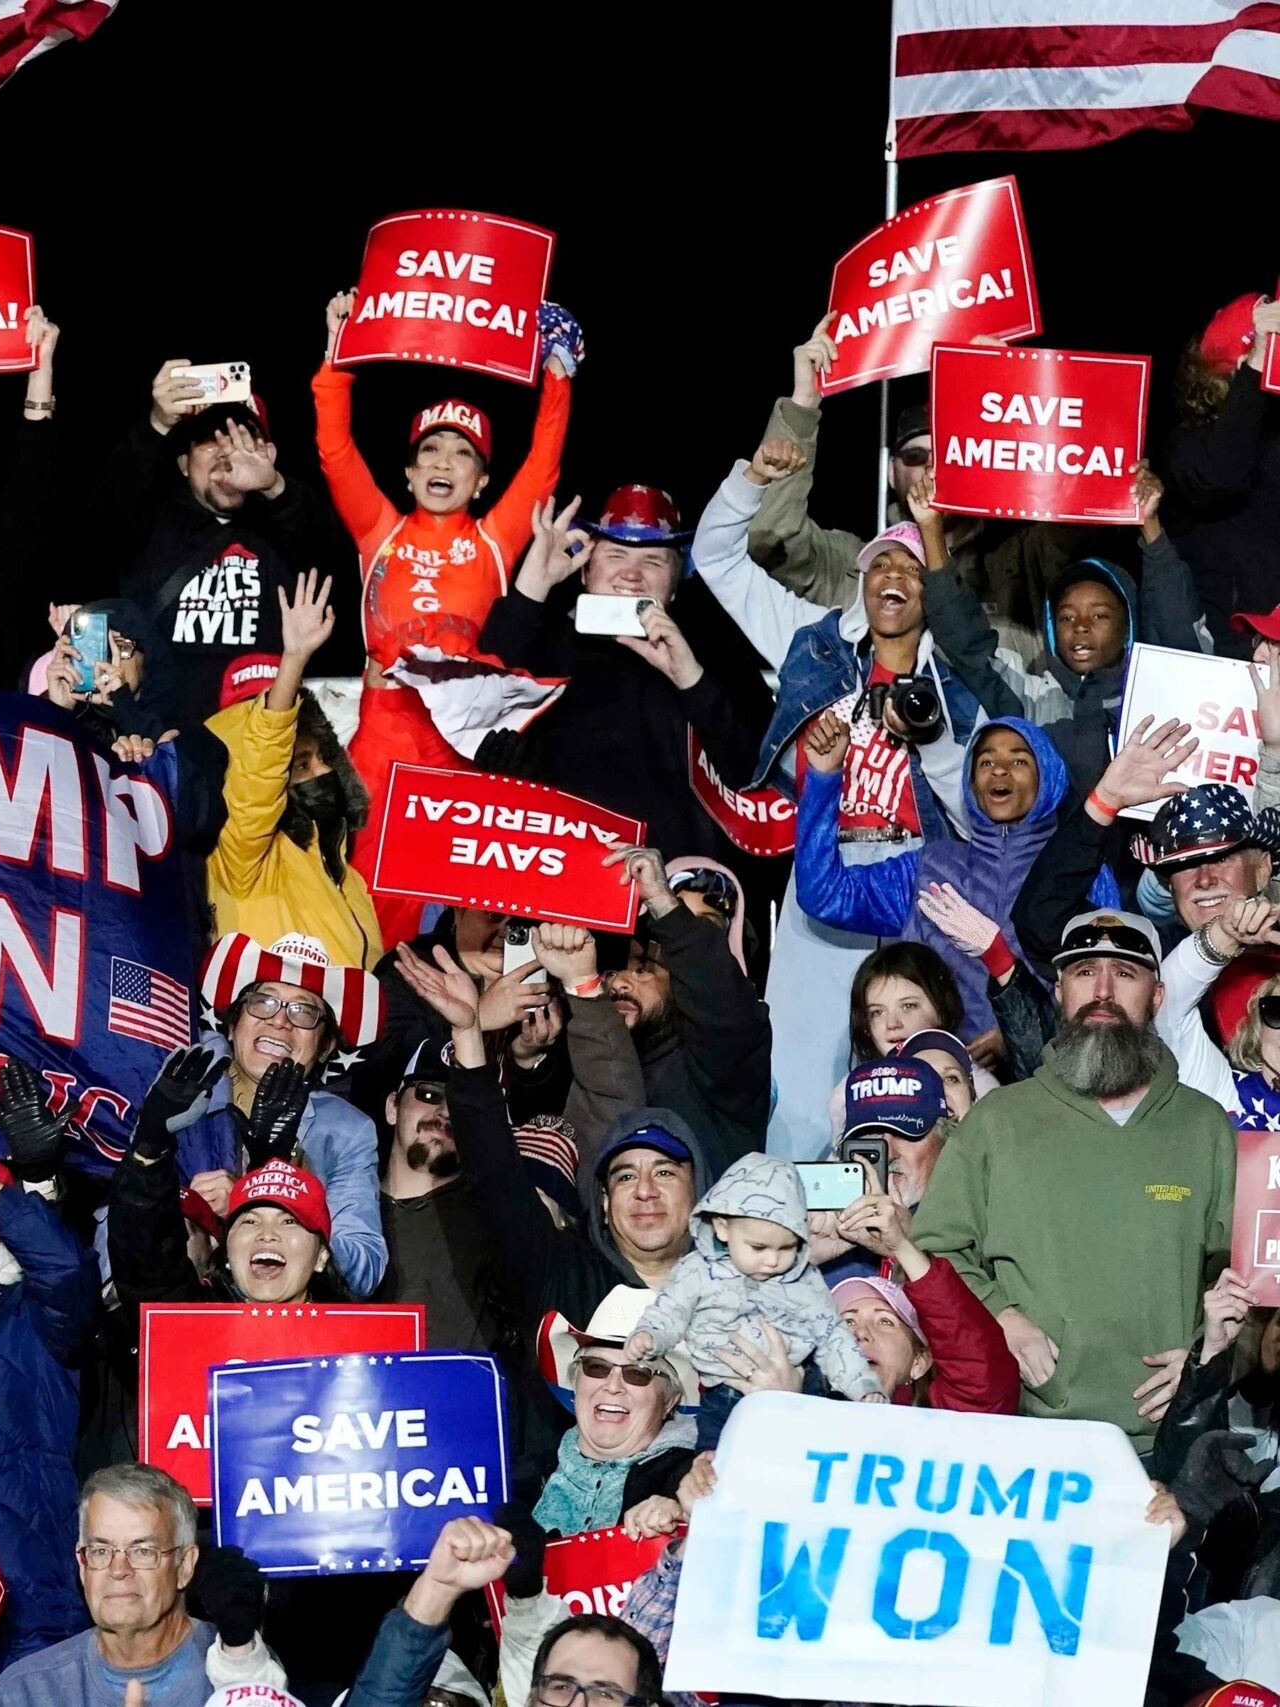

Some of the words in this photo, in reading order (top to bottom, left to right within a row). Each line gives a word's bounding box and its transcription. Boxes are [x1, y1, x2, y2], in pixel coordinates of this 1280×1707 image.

[396, 249, 495, 285] SAVE
[868, 235, 963, 288] SAVE
[355, 291, 527, 338] AMERICA!
[834, 268, 1014, 344] AMERICA!
[418, 401, 482, 437] MAGA
[980, 392, 1083, 428] SAVE
[945, 436, 1124, 477] AMERICA!
[180, 566, 261, 603] ALECS
[172, 610, 259, 645] KYLE
[231, 664, 279, 685] TRUM
[698, 749, 793, 823] AMERIC
[405, 794, 620, 844] AMERICA!
[449, 837, 567, 876] SAVE
[275, 945, 326, 964] TRUMP
[850, 1077, 922, 1102] TRUMP
[241, 1172, 309, 1194] AMERICA
[247, 1185, 300, 1200] GREAT
[291, 1408, 428, 1454] SAVE
[235, 1466, 489, 1518] AMERICA!
[806, 1450, 1093, 1522] TRUMP
[756, 1520, 1094, 1657] WON
